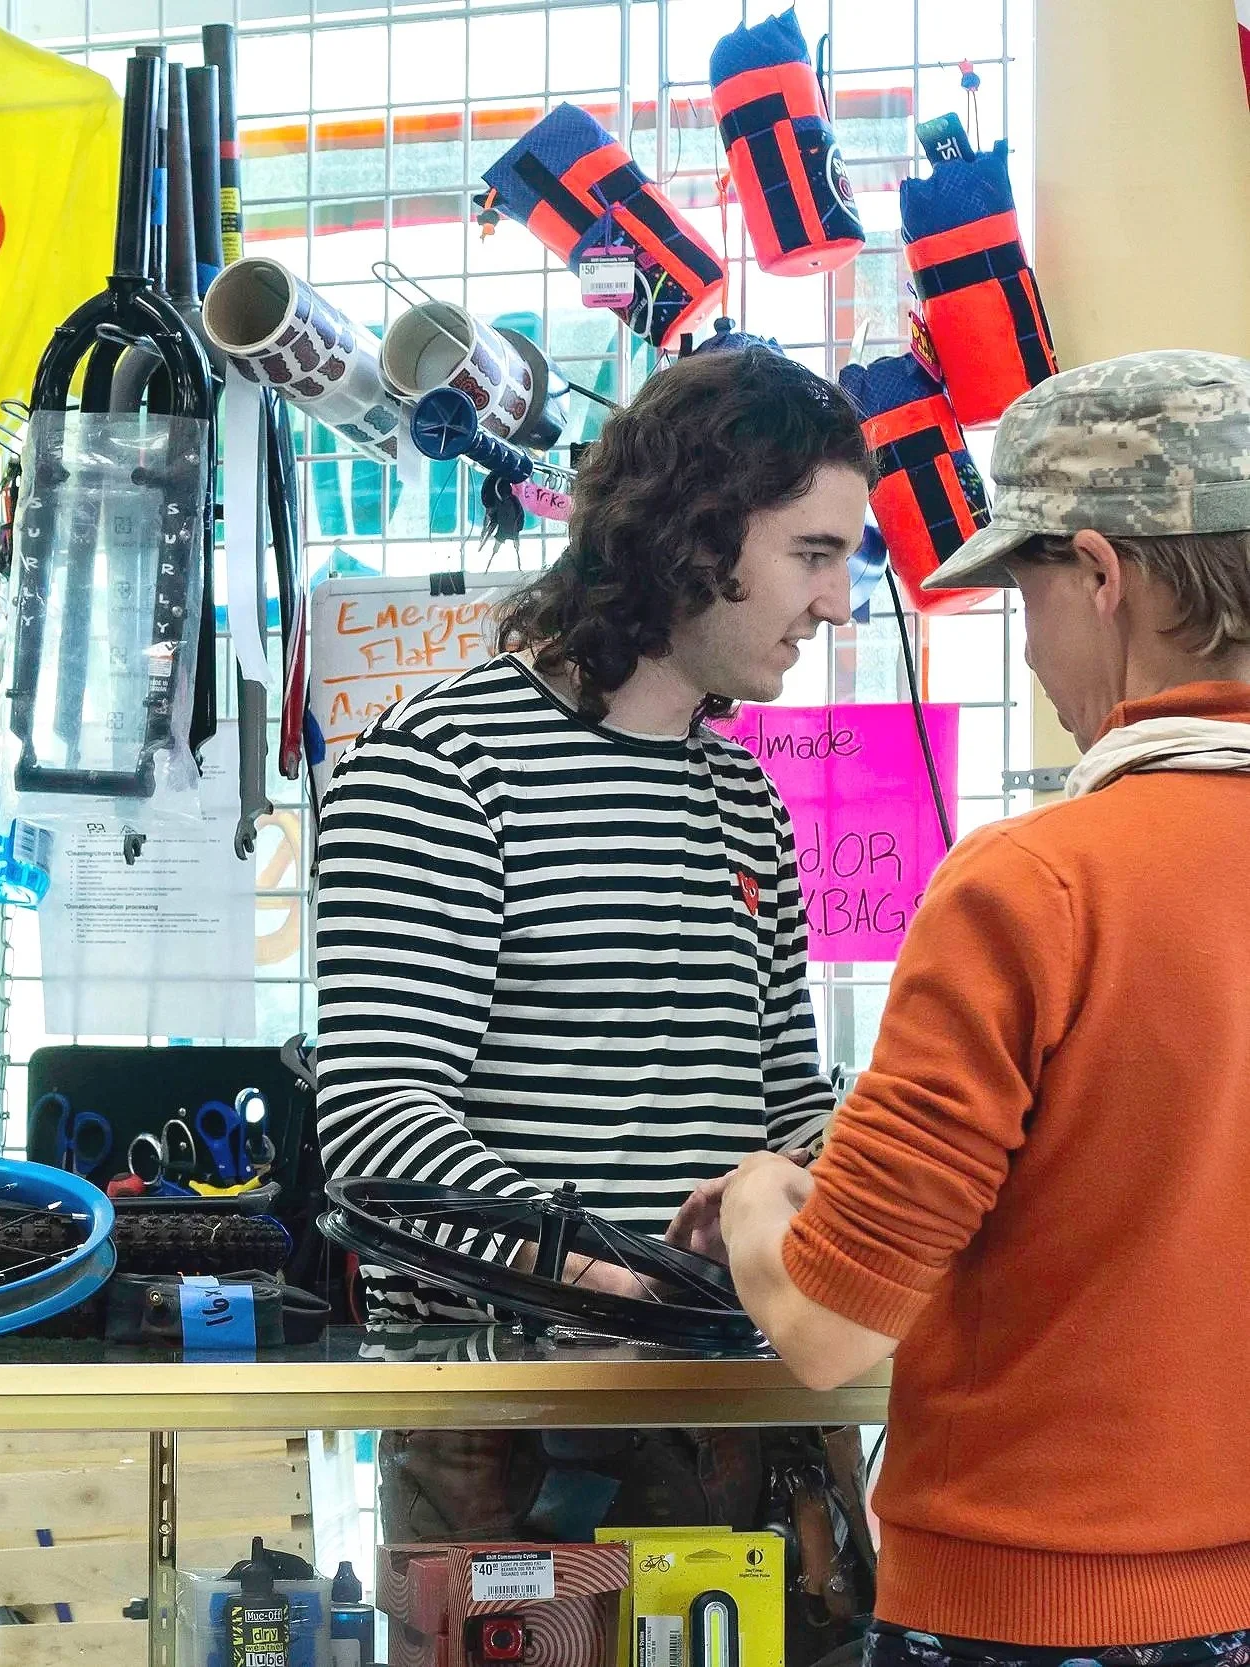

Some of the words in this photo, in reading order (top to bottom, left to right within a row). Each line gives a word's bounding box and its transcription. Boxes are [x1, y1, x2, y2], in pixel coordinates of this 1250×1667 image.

[155, 501, 180, 635] SURLY
[337, 601, 493, 644] Emergen
[359, 631, 446, 669] Flat
[245, 1610, 282, 1622] Muc-Off
[253, 1628, 278, 1643] dry
[249, 1653, 285, 1667] lube
